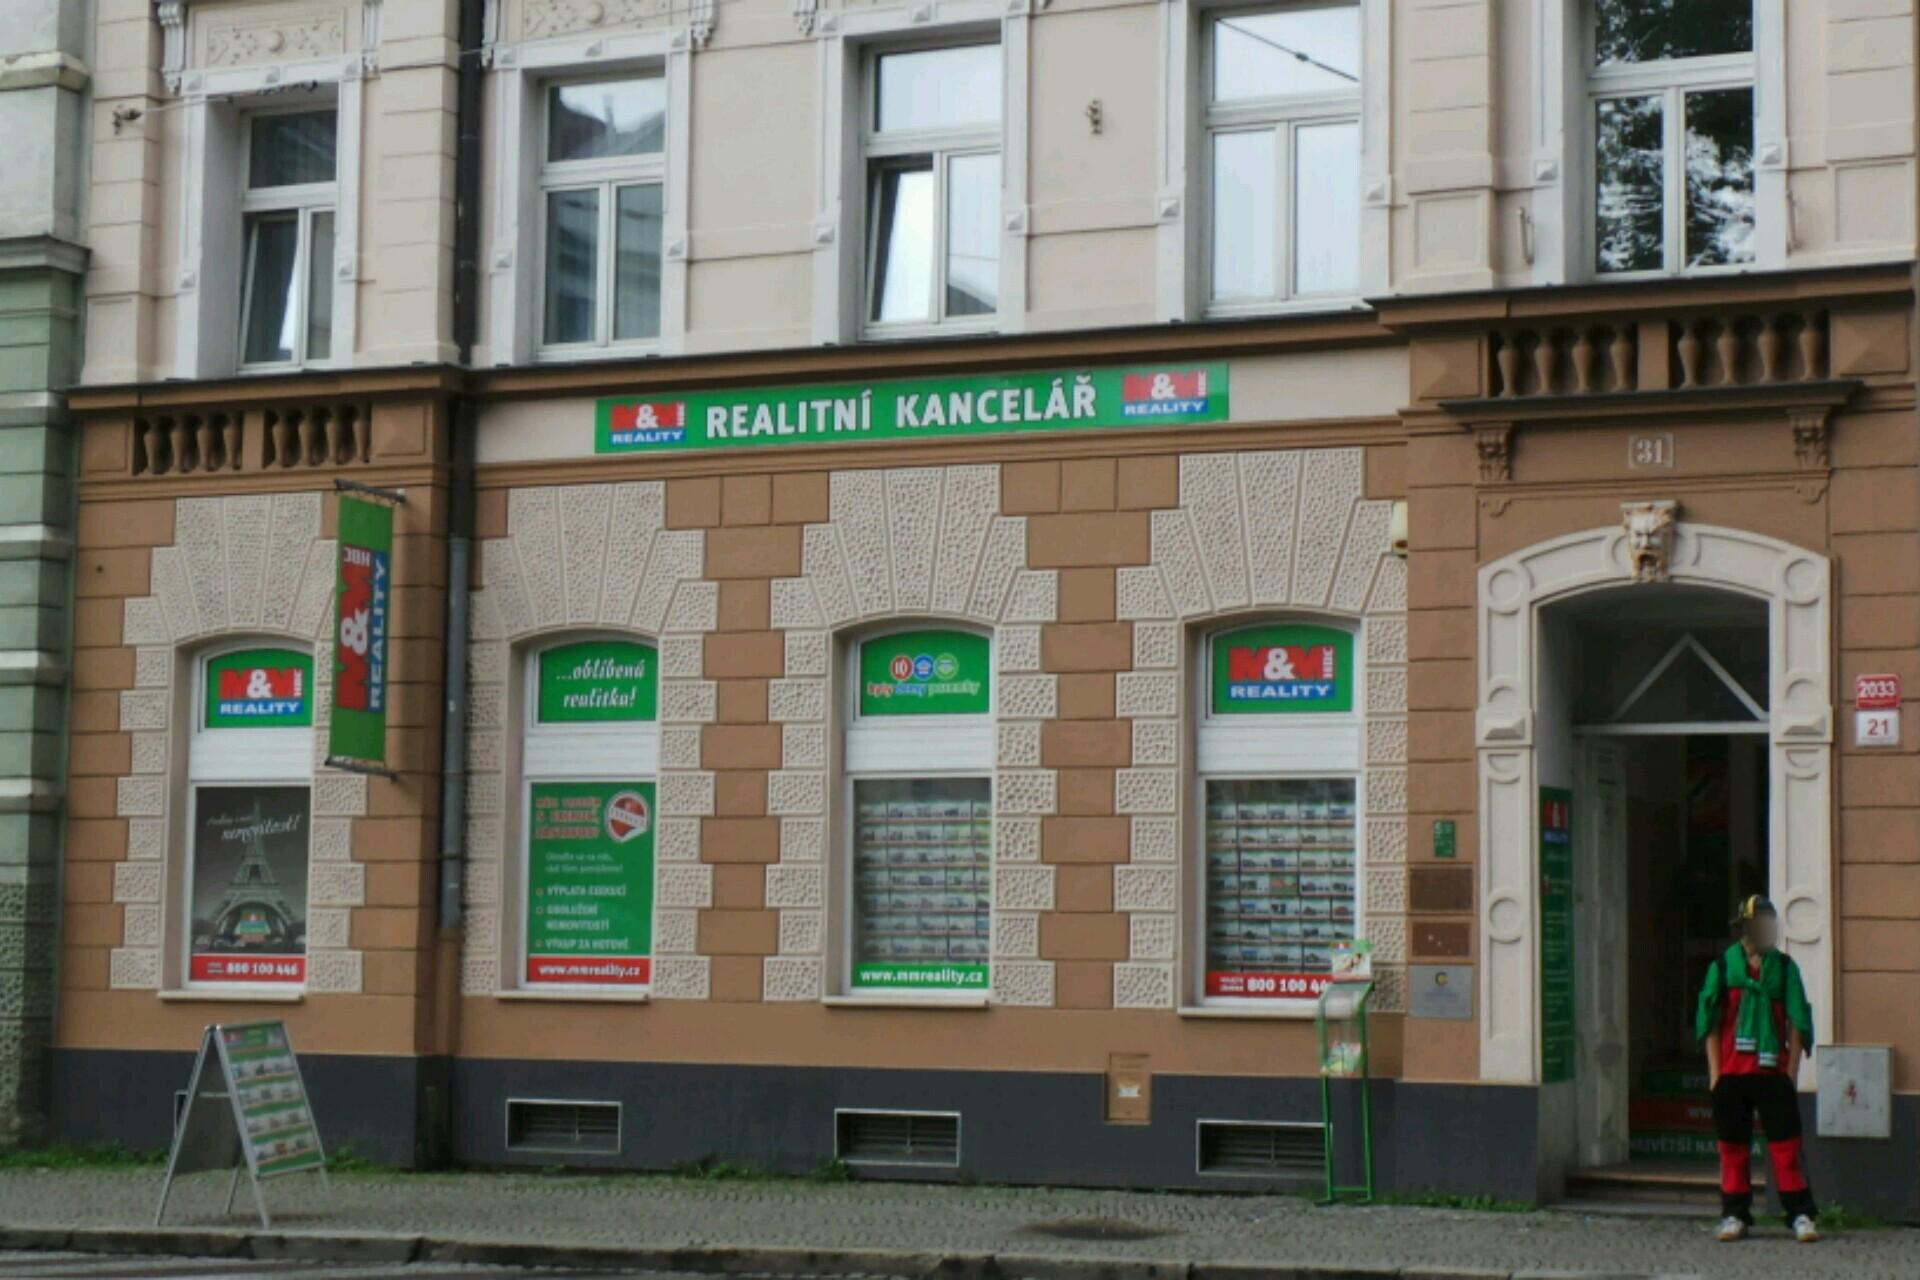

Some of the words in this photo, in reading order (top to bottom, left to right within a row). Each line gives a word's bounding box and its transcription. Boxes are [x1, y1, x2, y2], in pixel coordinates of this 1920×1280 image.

[706, 388, 873, 438] REALITNÍ
[895, 375, 1097, 428] KANCELÁŘ
[1124, 400, 1205, 416] REALITY
[612, 429, 683, 445] REALITY
[369, 558, 386, 709] REALITY
[1230, 684, 1331, 699] REALITY
[1857, 680, 1897, 698] 2033
[220, 701, 300, 715] REALITY
[1867, 718, 1889, 736] 21
[860, 967, 984, 985] www.mmreality.cz
[1246, 978, 1276, 993] 800
[1279, 979, 1307, 993] 100
